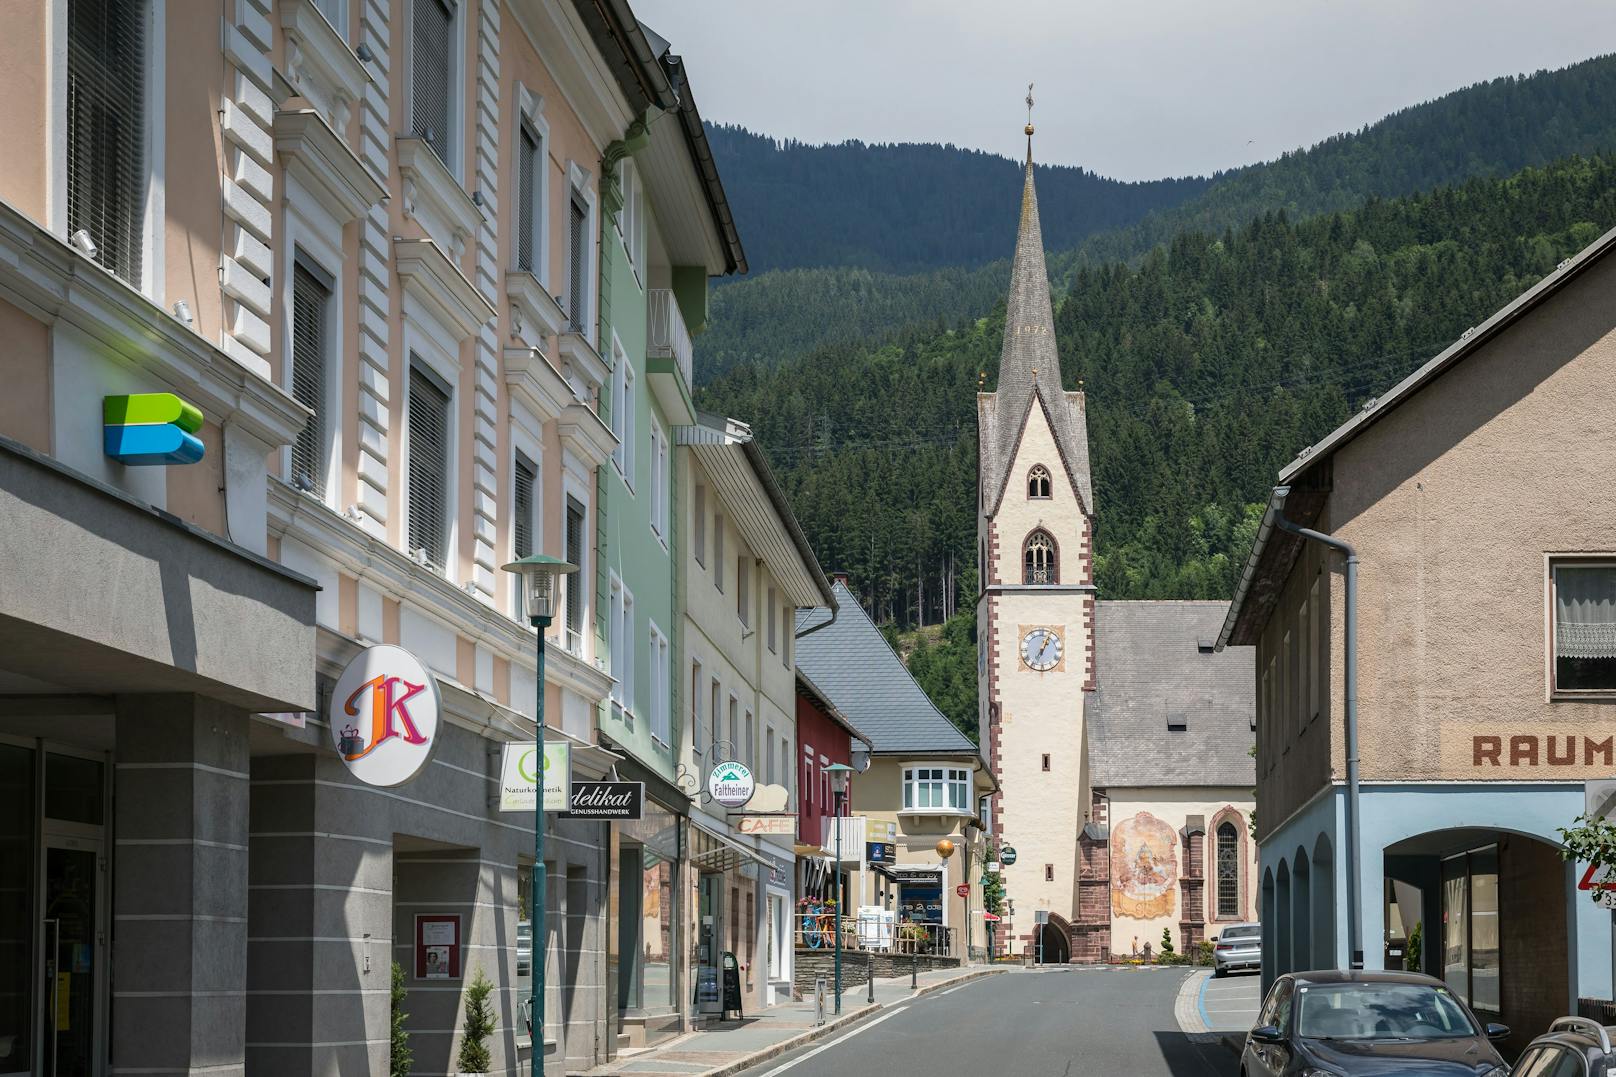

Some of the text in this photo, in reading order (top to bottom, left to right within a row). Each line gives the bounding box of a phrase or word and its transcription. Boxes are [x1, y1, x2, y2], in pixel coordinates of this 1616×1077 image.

[712, 762, 750, 779] Zimmerei
[571, 786, 632, 807] delikat
[714, 783, 750, 797] Faltheiner
